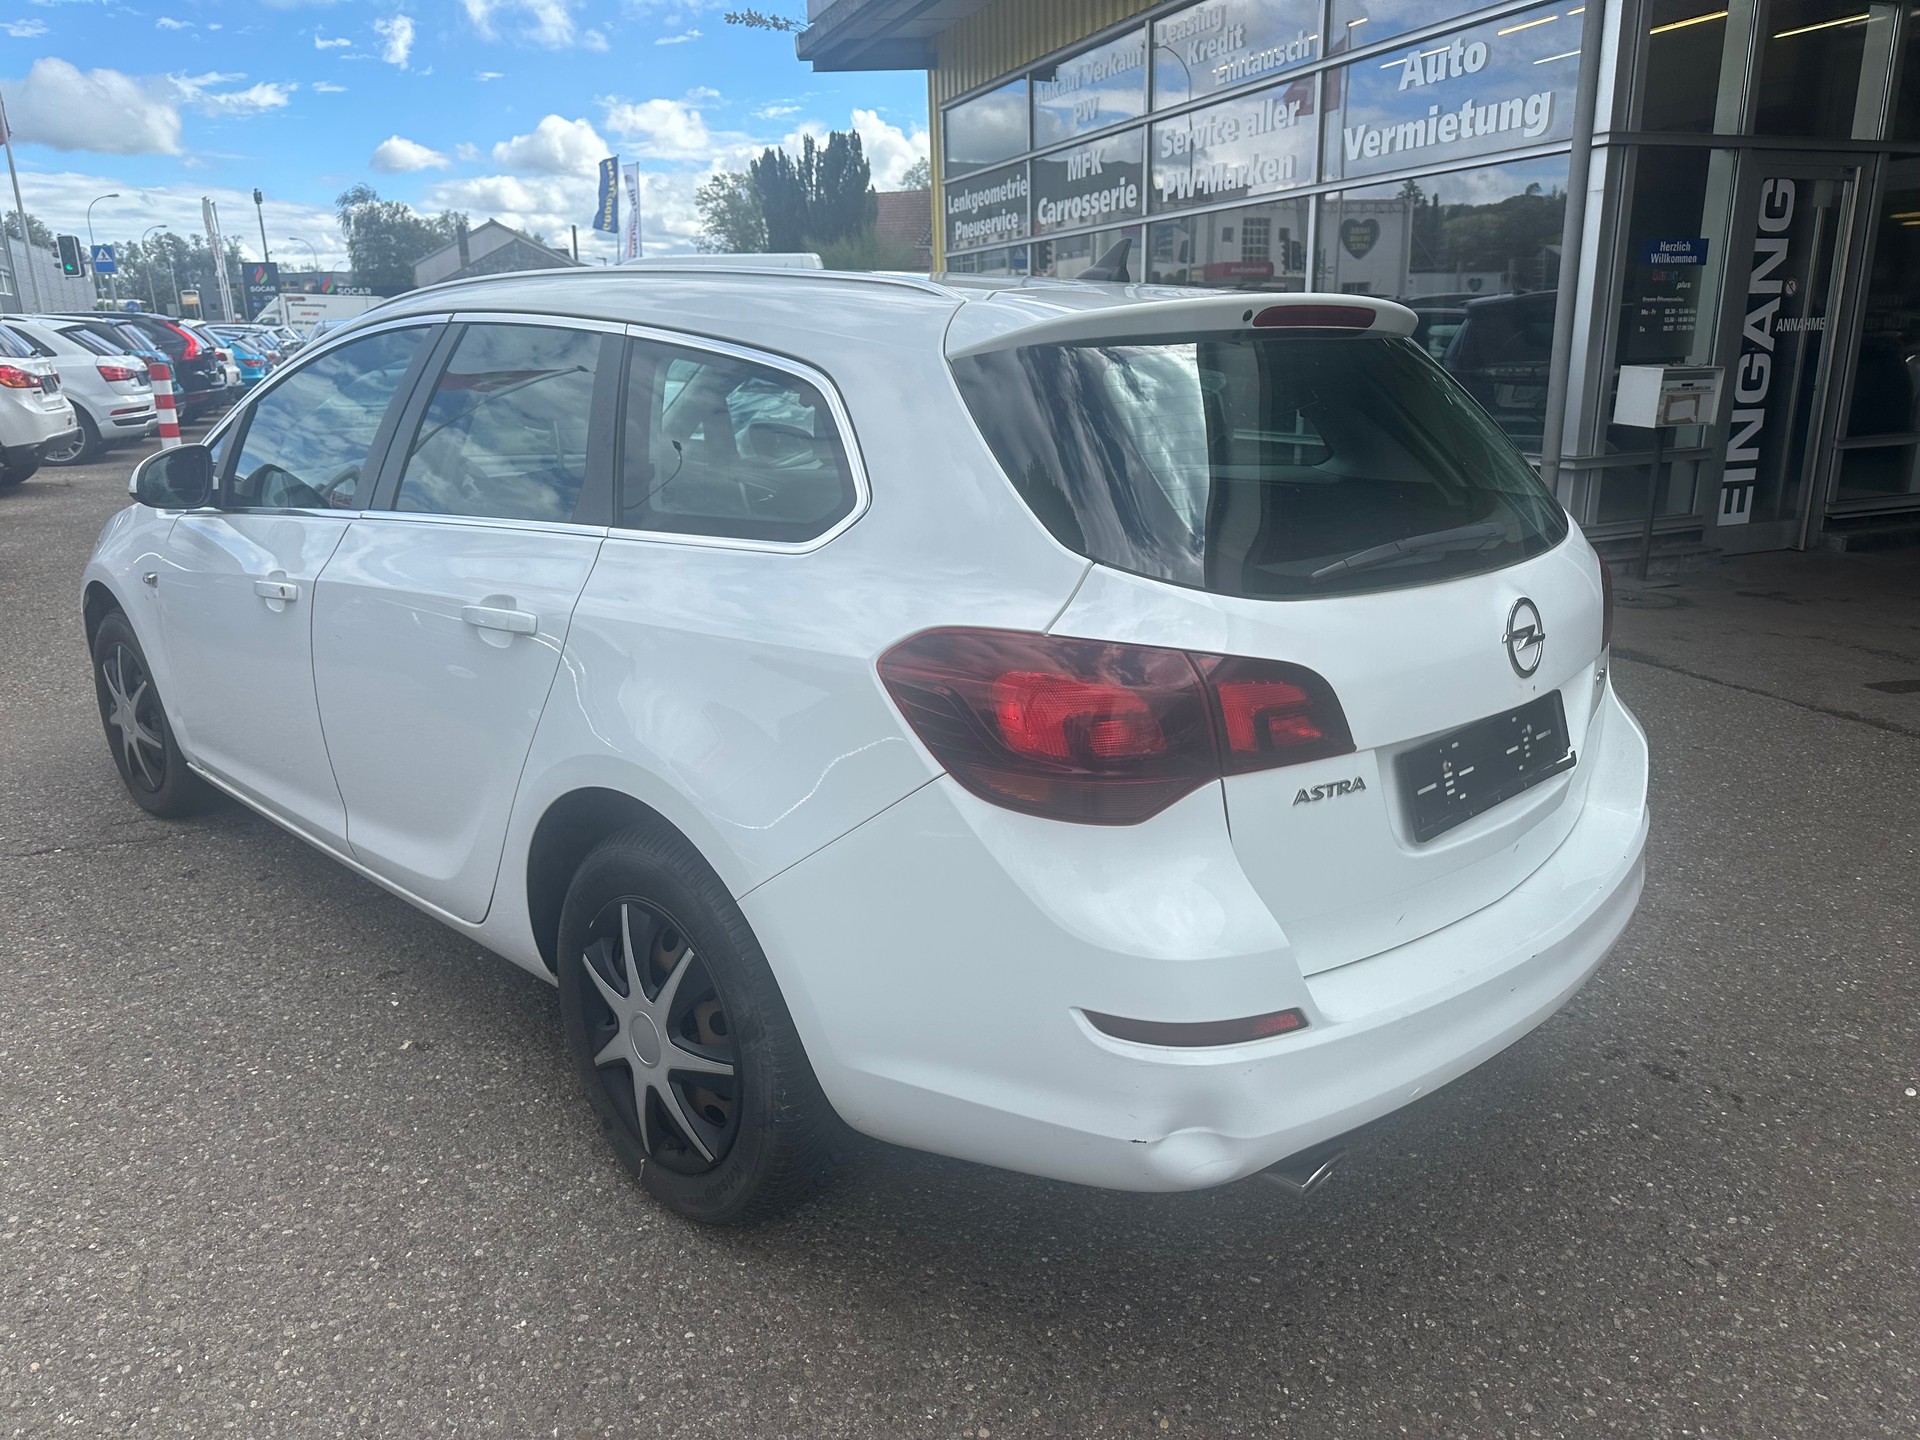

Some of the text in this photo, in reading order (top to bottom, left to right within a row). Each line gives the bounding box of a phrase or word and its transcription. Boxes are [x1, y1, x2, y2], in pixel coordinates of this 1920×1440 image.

[1157, 3, 1225, 45] Leasing
[1187, 23, 1246, 67] Kredit
[1214, 30, 1311, 87] Eintausch
[1398, 38, 1490, 91] Auto
[1036, 46, 1144, 103] Ankauf Verkauf
[1073, 96, 1099, 125] PW
[1161, 99, 1300, 158] Service aller
[1344, 92, 1552, 161] Vermietung
[1067, 150, 1103, 182] MFK
[1162, 152, 1294, 203] PW-Marken
[948, 174, 1028, 215] Lenkgeometrie
[1037, 176, 1138, 225] Carrosserie
[955, 208, 1019, 241] Pneuservice
[1650, 252, 1698, 264] Willkommen
[1659, 241, 1691, 252] Herzlich
[250, 285, 276, 293] SOCAR
[336, 287, 372, 296] SOCAR
[1676, 281, 1692, 290] plus
[1775, 317, 1826, 332] ANNAHME
[1717, 178, 1796, 526] EINGANG
[1292, 776, 1367, 806] ASTRA
